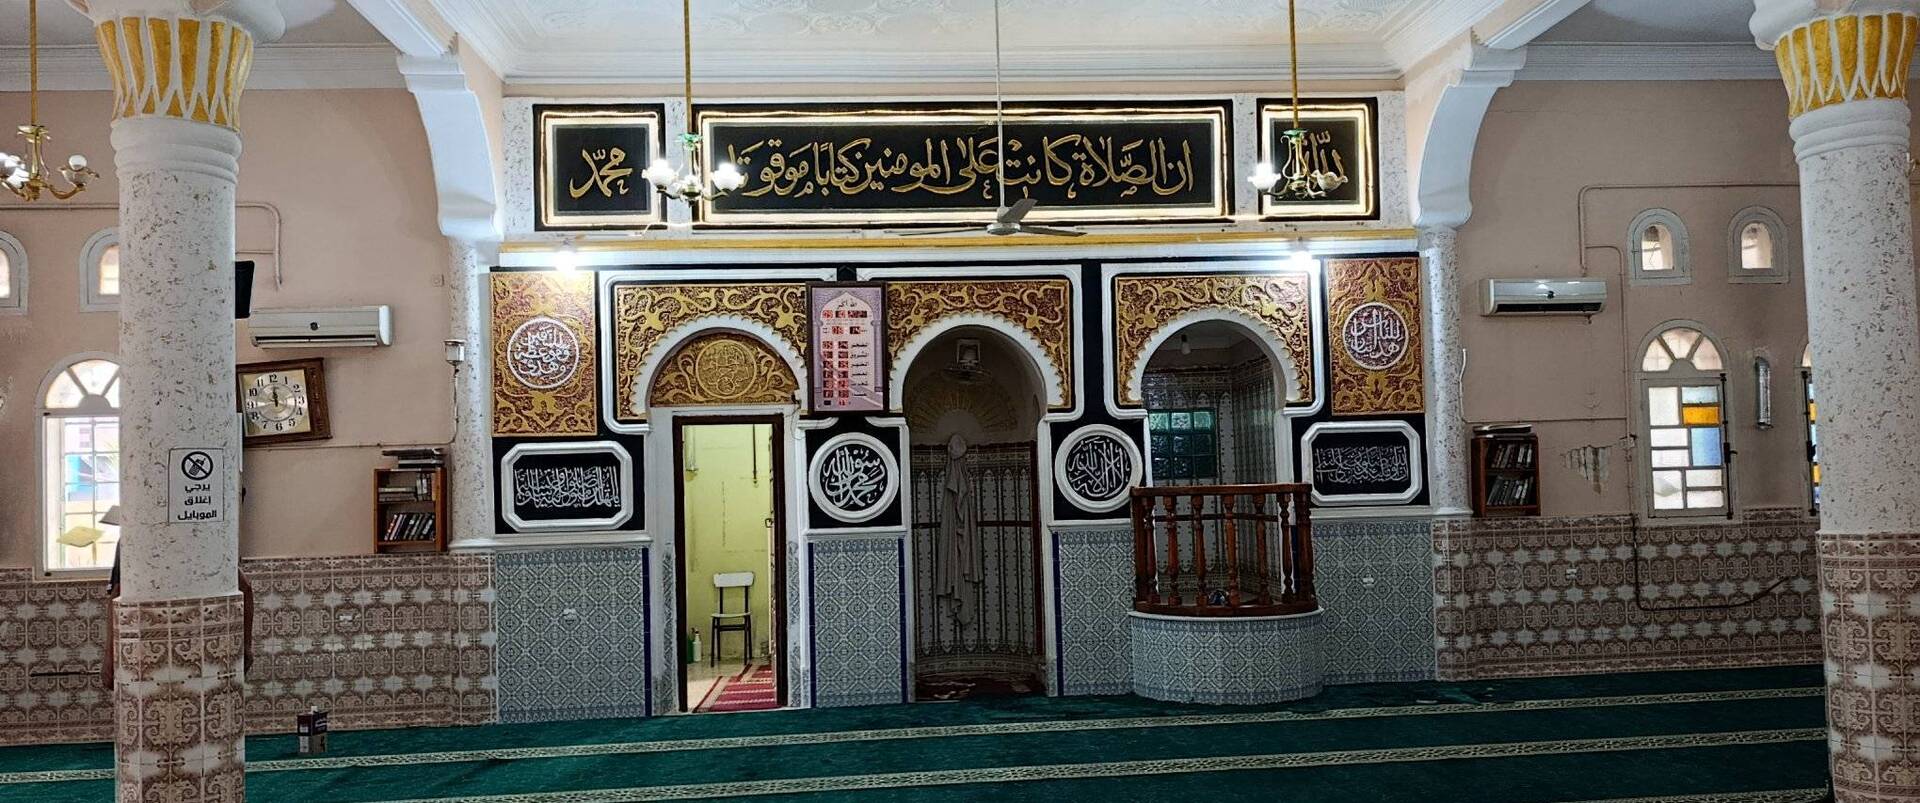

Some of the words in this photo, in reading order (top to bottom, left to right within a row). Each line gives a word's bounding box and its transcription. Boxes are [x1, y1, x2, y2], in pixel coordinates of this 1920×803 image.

[257, 378, 264, 387] 11
[269, 374, 278, 383] 12
[284, 376, 288, 385] 1
[248, 387, 258, 397] 10
[293, 384, 301, 393] 2
[246, 401, 254, 409] 9
[298, 396, 305, 405] 3
[251, 411, 259, 420] 8
[296, 407, 303, 416] 4
[262, 421, 268, 429] 7
[275, 422, 283, 431] 6
[288, 418, 296, 427] 5
